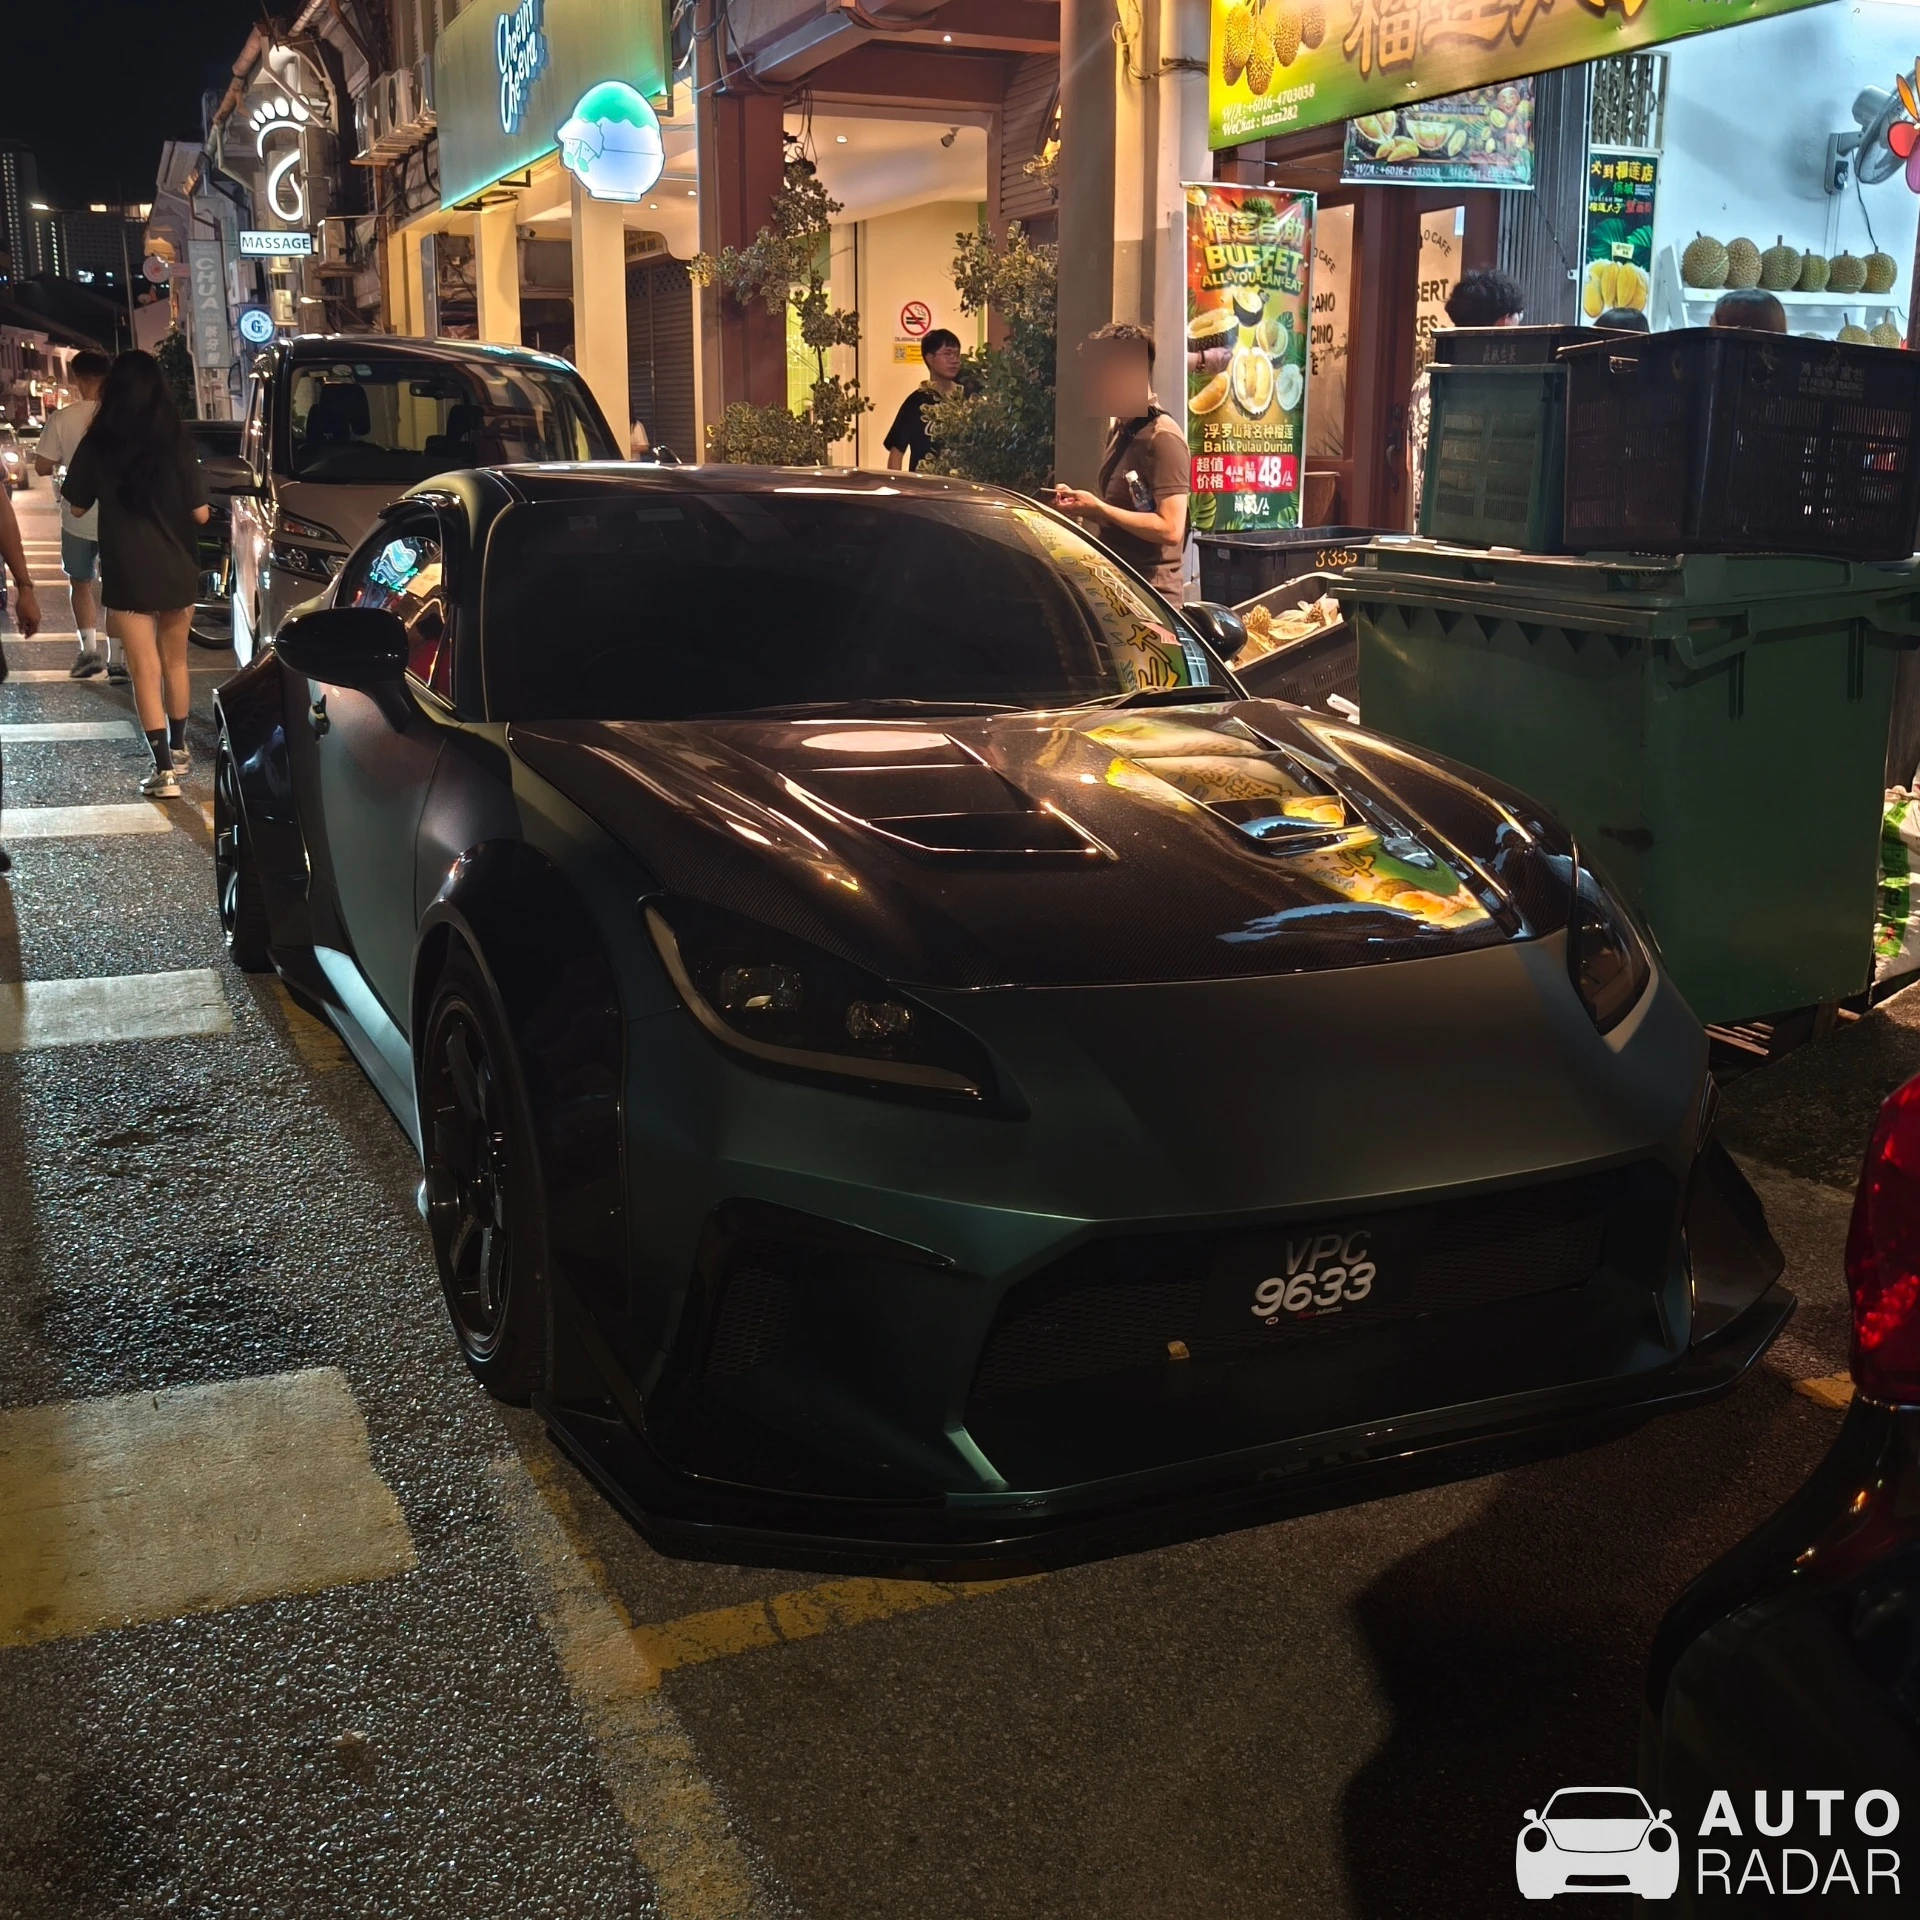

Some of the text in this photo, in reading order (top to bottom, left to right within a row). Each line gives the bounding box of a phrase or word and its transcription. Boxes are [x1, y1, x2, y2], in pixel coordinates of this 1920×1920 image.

[501, 32, 537, 133] Cheeva
[242, 236, 310, 249] MASSAGE
[1205, 244, 1304, 275] BUFFET
[195, 257, 219, 310] CHUA
[1204, 423, 1294, 439] 浮罗山背名种榴莲
[1204, 440, 1293, 453] Balik Pulau Durian
[1196, 456, 1224, 473] 超值
[1196, 473, 1224, 489] 价格
[1286, 1230, 1371, 1275] VPC
[1251, 1261, 1377, 1316] 9633
